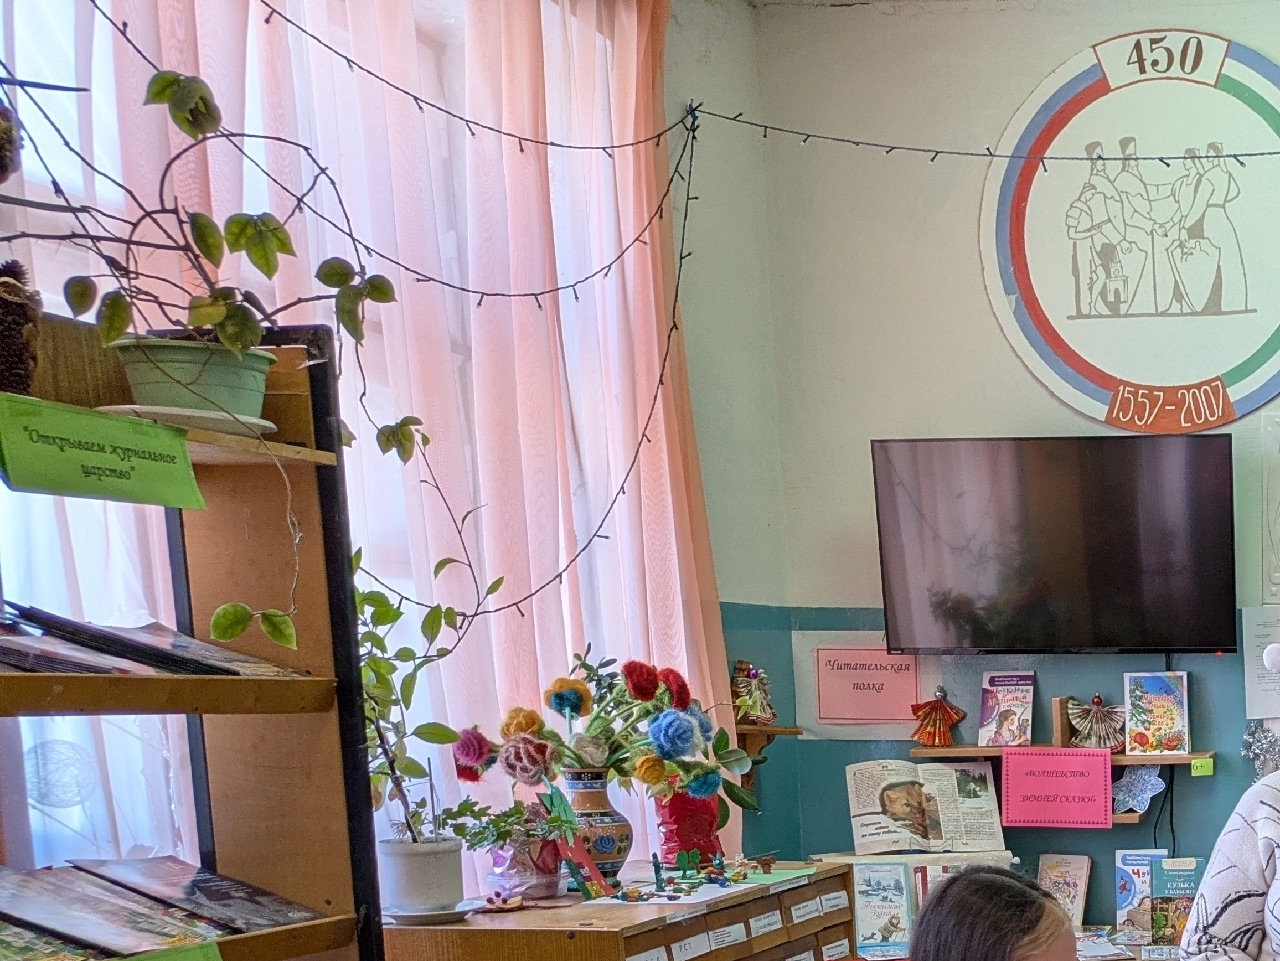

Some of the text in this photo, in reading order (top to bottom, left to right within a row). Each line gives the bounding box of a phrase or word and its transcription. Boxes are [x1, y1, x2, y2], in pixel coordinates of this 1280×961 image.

[1126, 36, 1203, 75] 450
[1112, 381, 1223, 427] 1557-2007
[825, 659, 911, 674] Читательская
[852, 682, 885, 693] полка
[1019, 794, 1059, 803] ЗИМНЕЙ
